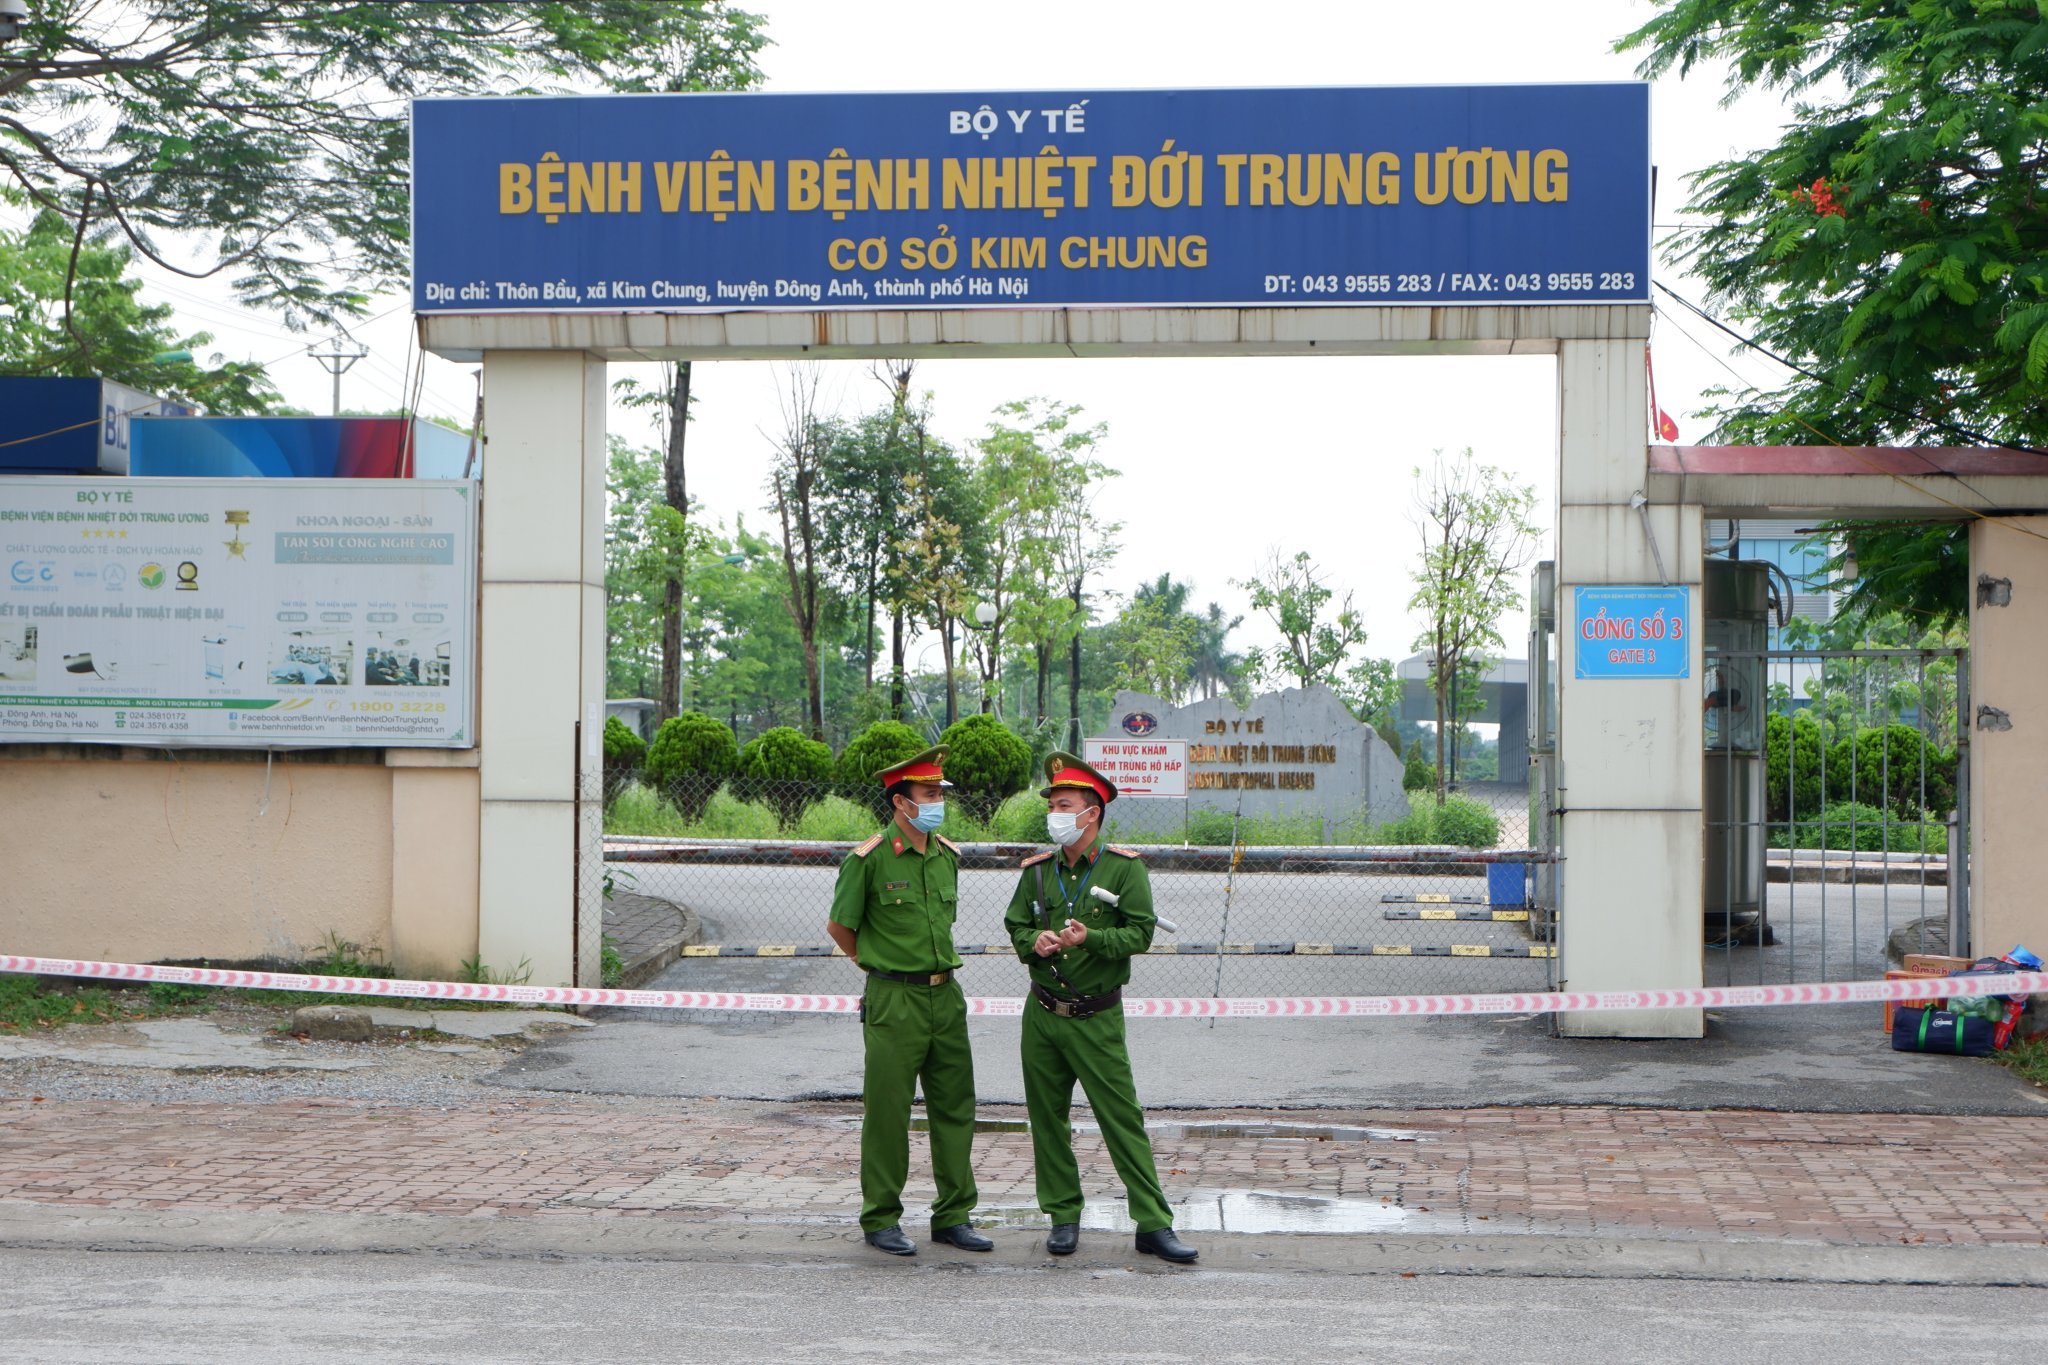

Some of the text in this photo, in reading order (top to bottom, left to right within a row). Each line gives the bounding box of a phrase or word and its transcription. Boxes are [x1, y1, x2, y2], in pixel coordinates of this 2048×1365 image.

[950, 100, 1090, 140] BỘ Y TẾ
[500, 139, 1569, 224] BỆNH VIỆN BỆNH NHIỆT ĐỚI TRUNG ƯƠNG
[829, 224, 1208, 270] CƠ SỞ KIM CHUNG
[426, 274, 1029, 304] Địa chỉ: Thôn Bầu, xã Kim Chung, huyện Đông Anh, thành phố Hà Nội
[1264, 272, 1635, 293] ĐT: 043 9555 283 / FAX: 043 9555 283
[76, 489, 134, 505] BỘ Y TẾ
[0, 509, 210, 525] BỆNH VIỆN BỆNH NHIỆT ĐỚI TRUNG ƯƠNG
[296, 515, 339, 527] KHOA
[342, 515, 390, 529] NGOẠI
[402, 514, 433, 527] SẢN
[1582, 606, 1683, 640] CỔNG SỐ 3
[1609, 649, 1656, 663] GATE 3
[351, 701, 447, 713] 1900 3228
[241, 724, 325, 732] www.benhnhietdoi.vn
[1206, 716, 1265, 736] BỘ Y TẾ
[1102, 743, 1167, 757] KHU VỰC KHÁM
[1272, 744, 1305, 763] TRUNG
[1118, 759, 1147, 771] TRÙNG
[1150, 760, 1162, 771] HÔ
[1164, 758, 1182, 772] HẤP
[1142, 773, 1152, 784] SỐ
[1153, 776, 1159, 784] 2
[1278, 771, 1315, 790] DISEASES
